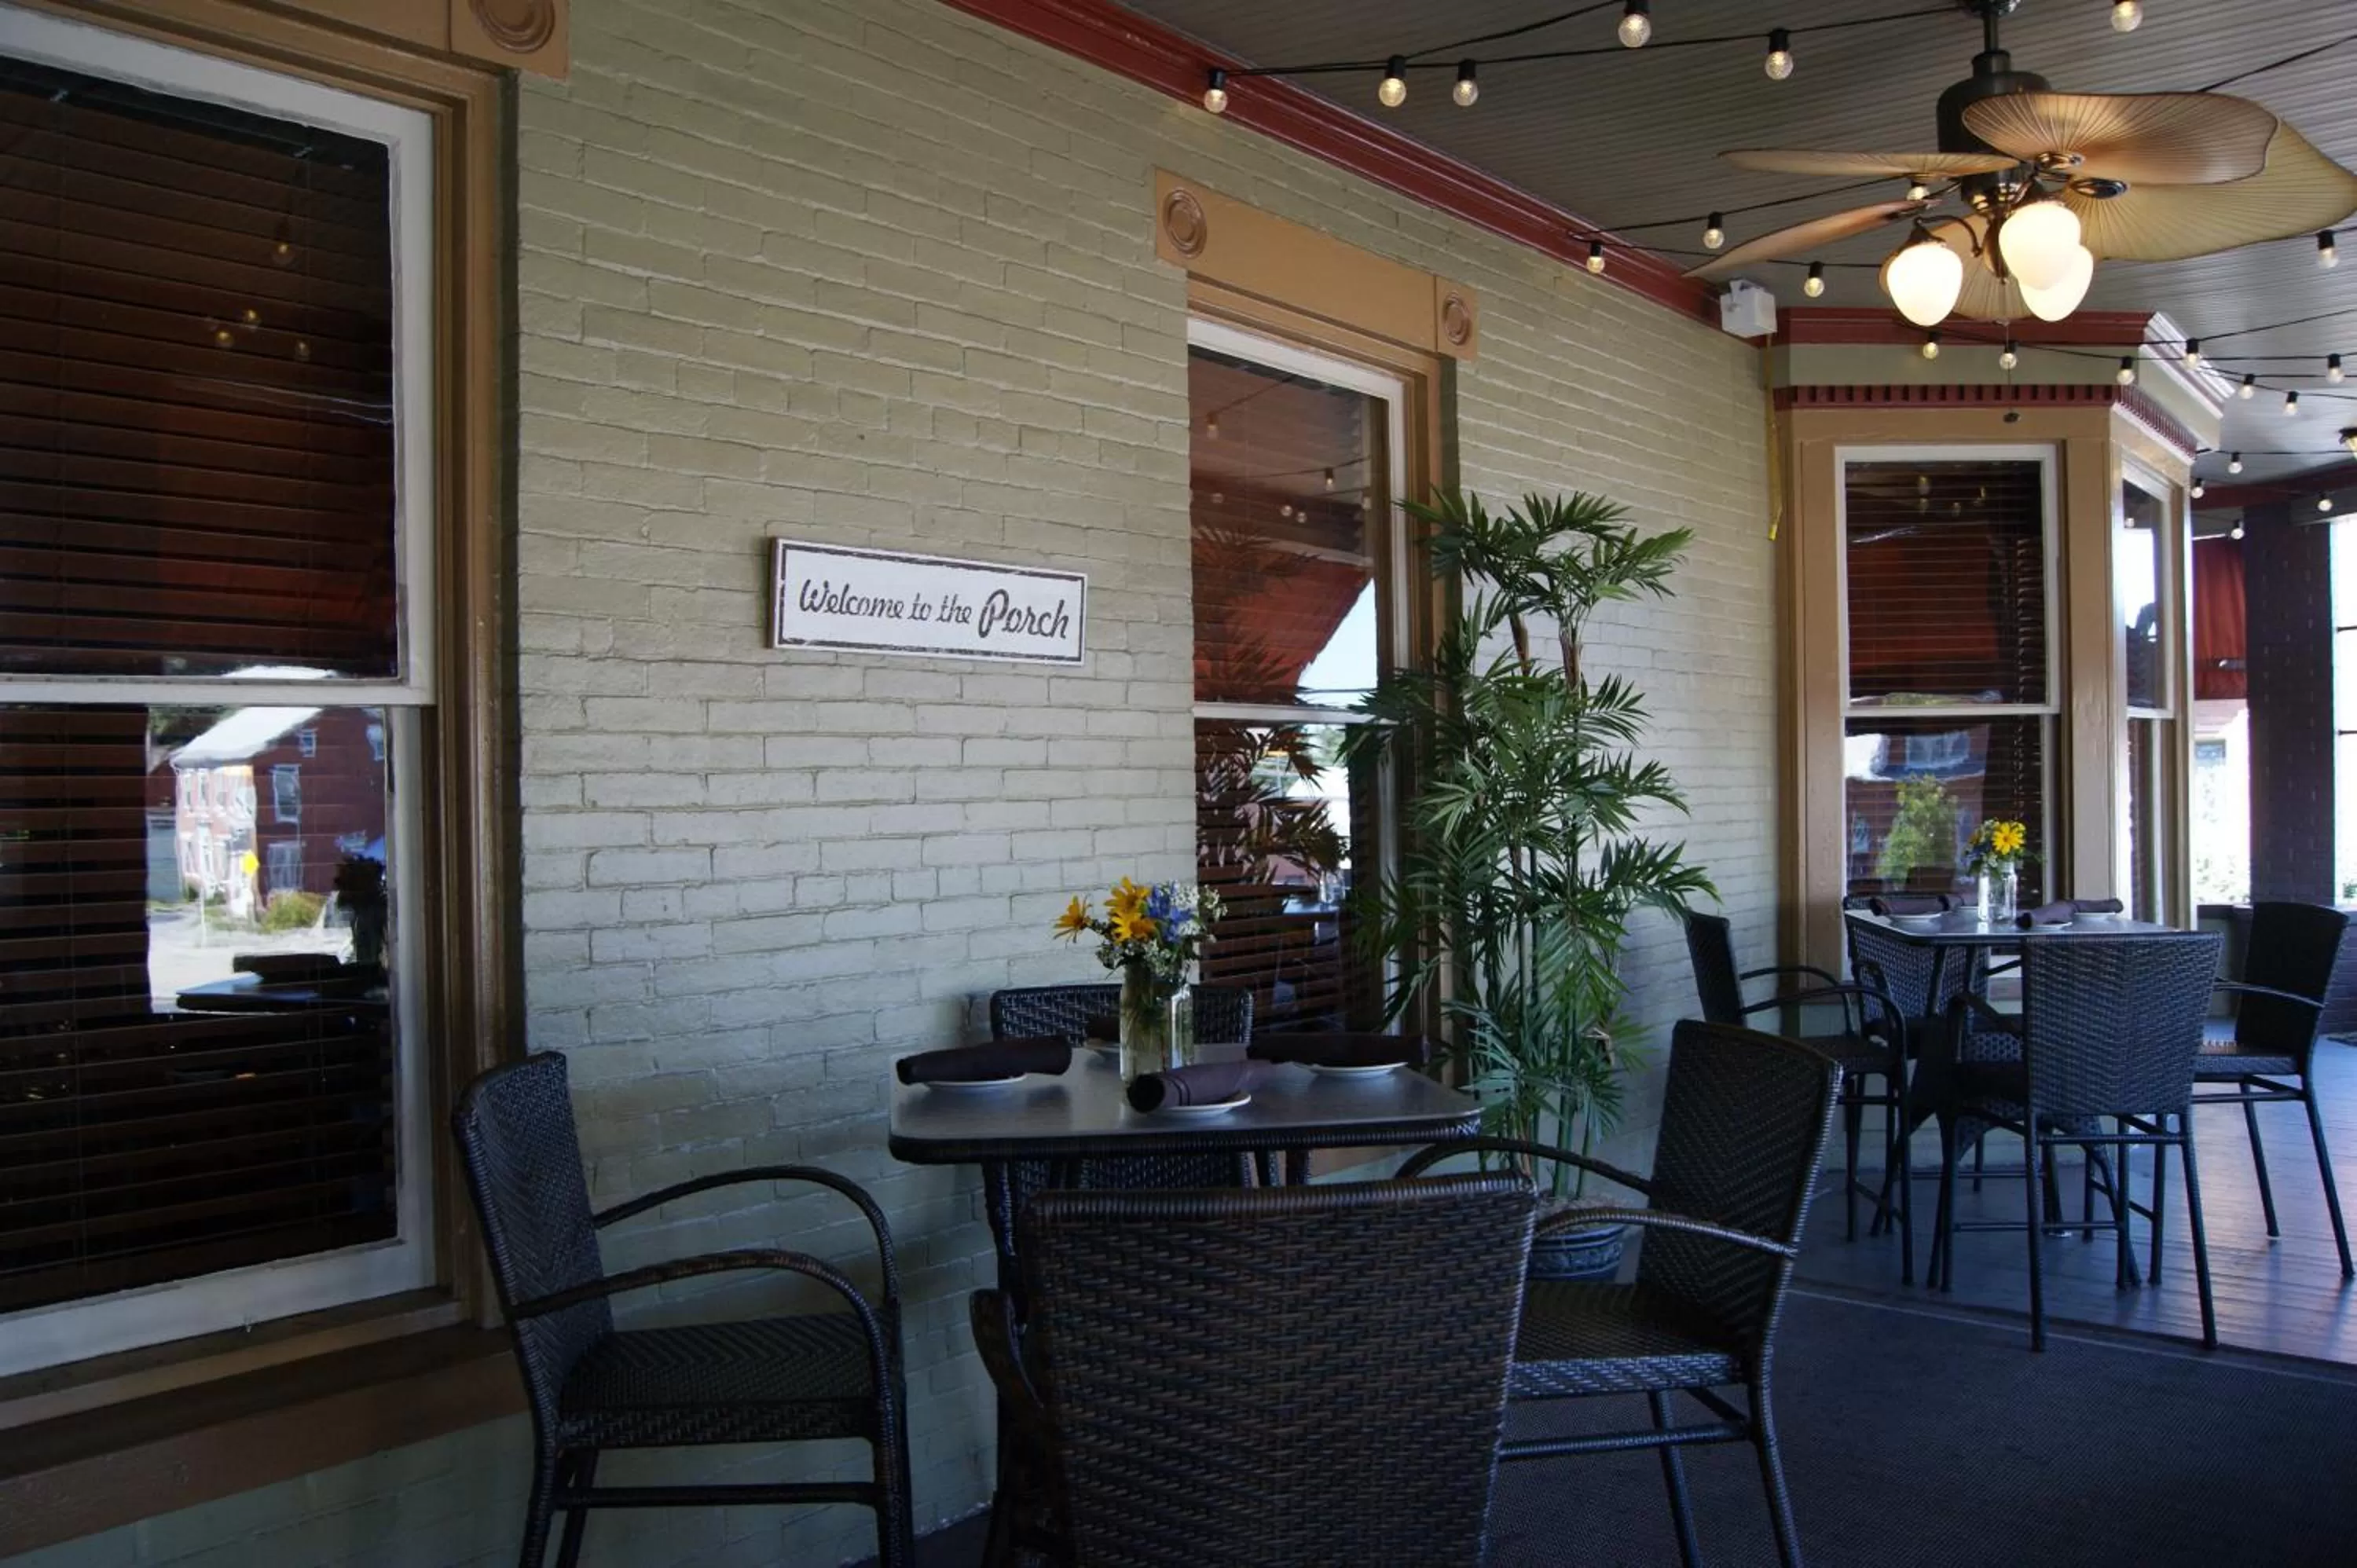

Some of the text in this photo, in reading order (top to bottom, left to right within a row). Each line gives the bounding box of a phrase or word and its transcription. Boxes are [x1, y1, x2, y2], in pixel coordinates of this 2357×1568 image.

[799, 578, 1070, 639] Welcome to the Porch
